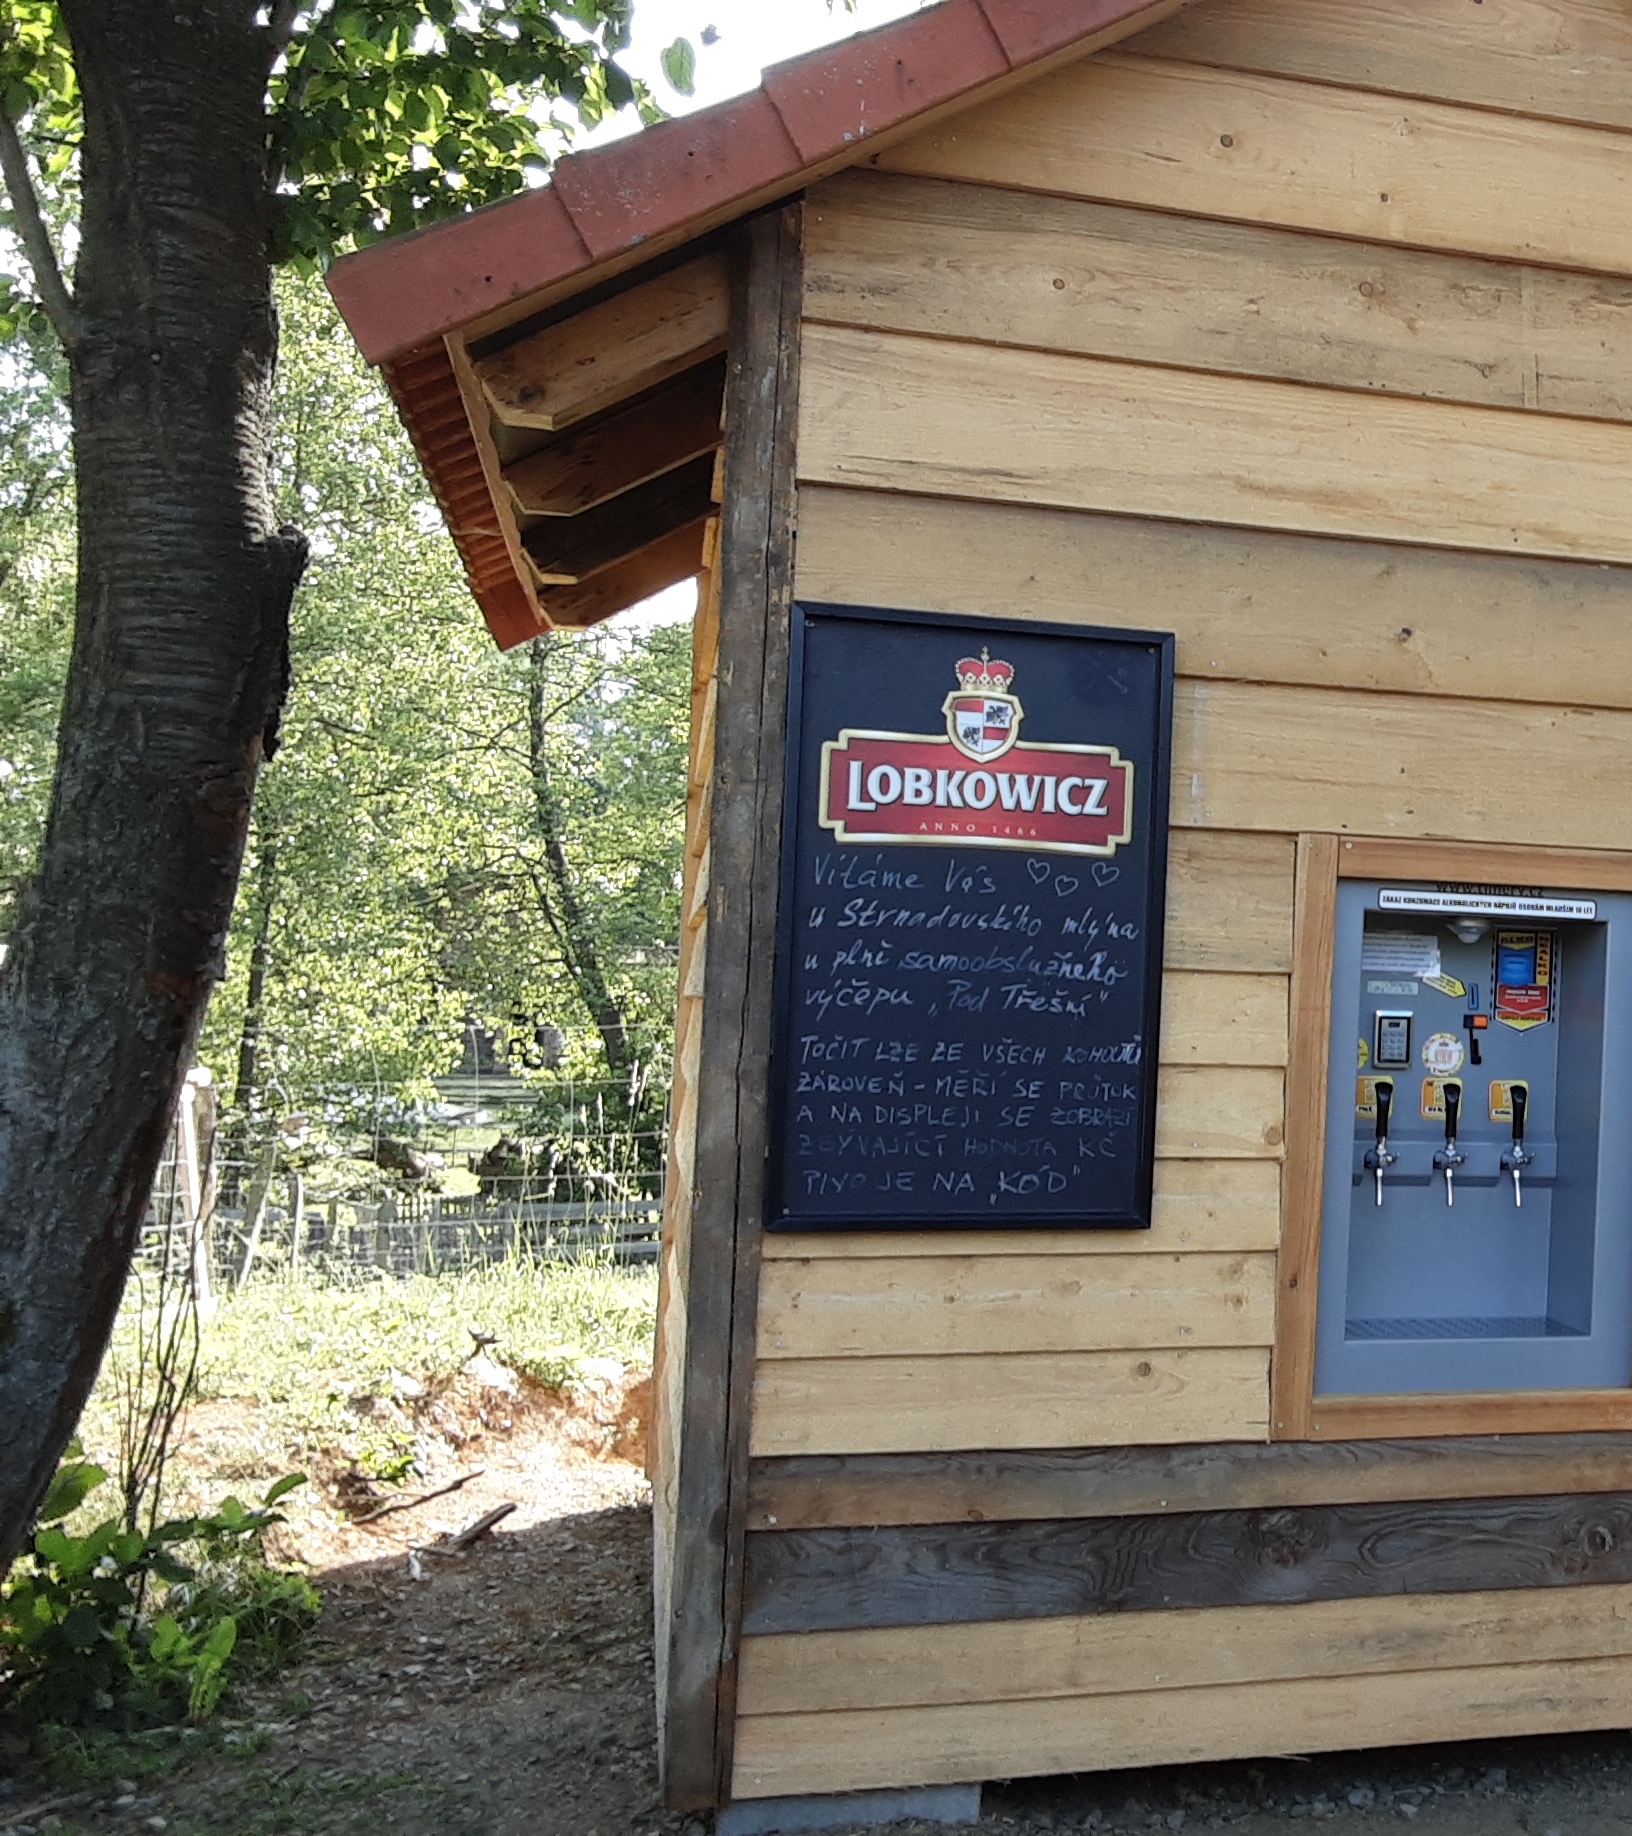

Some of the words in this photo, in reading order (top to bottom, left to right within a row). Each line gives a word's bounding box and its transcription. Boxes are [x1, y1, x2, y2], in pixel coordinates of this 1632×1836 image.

[846, 758, 1109, 816] LOBKOWICZ
[919, 821, 977, 833] ANNO
[800, 1034, 869, 1064] TOČIT
[982, 1038, 1046, 1066] VŠECH
[797, 1070, 905, 1096] ZÁROVEŇ
[1014, 1080, 1045, 1099] SE
[797, 1105, 813, 1124] A
[830, 1103, 863, 1123] NA
[1000, 1105, 1036, 1127] SE
[802, 1169, 867, 1195] PIVO
[876, 1169, 915, 1193] JE
[933, 1171, 976, 1195] NA
